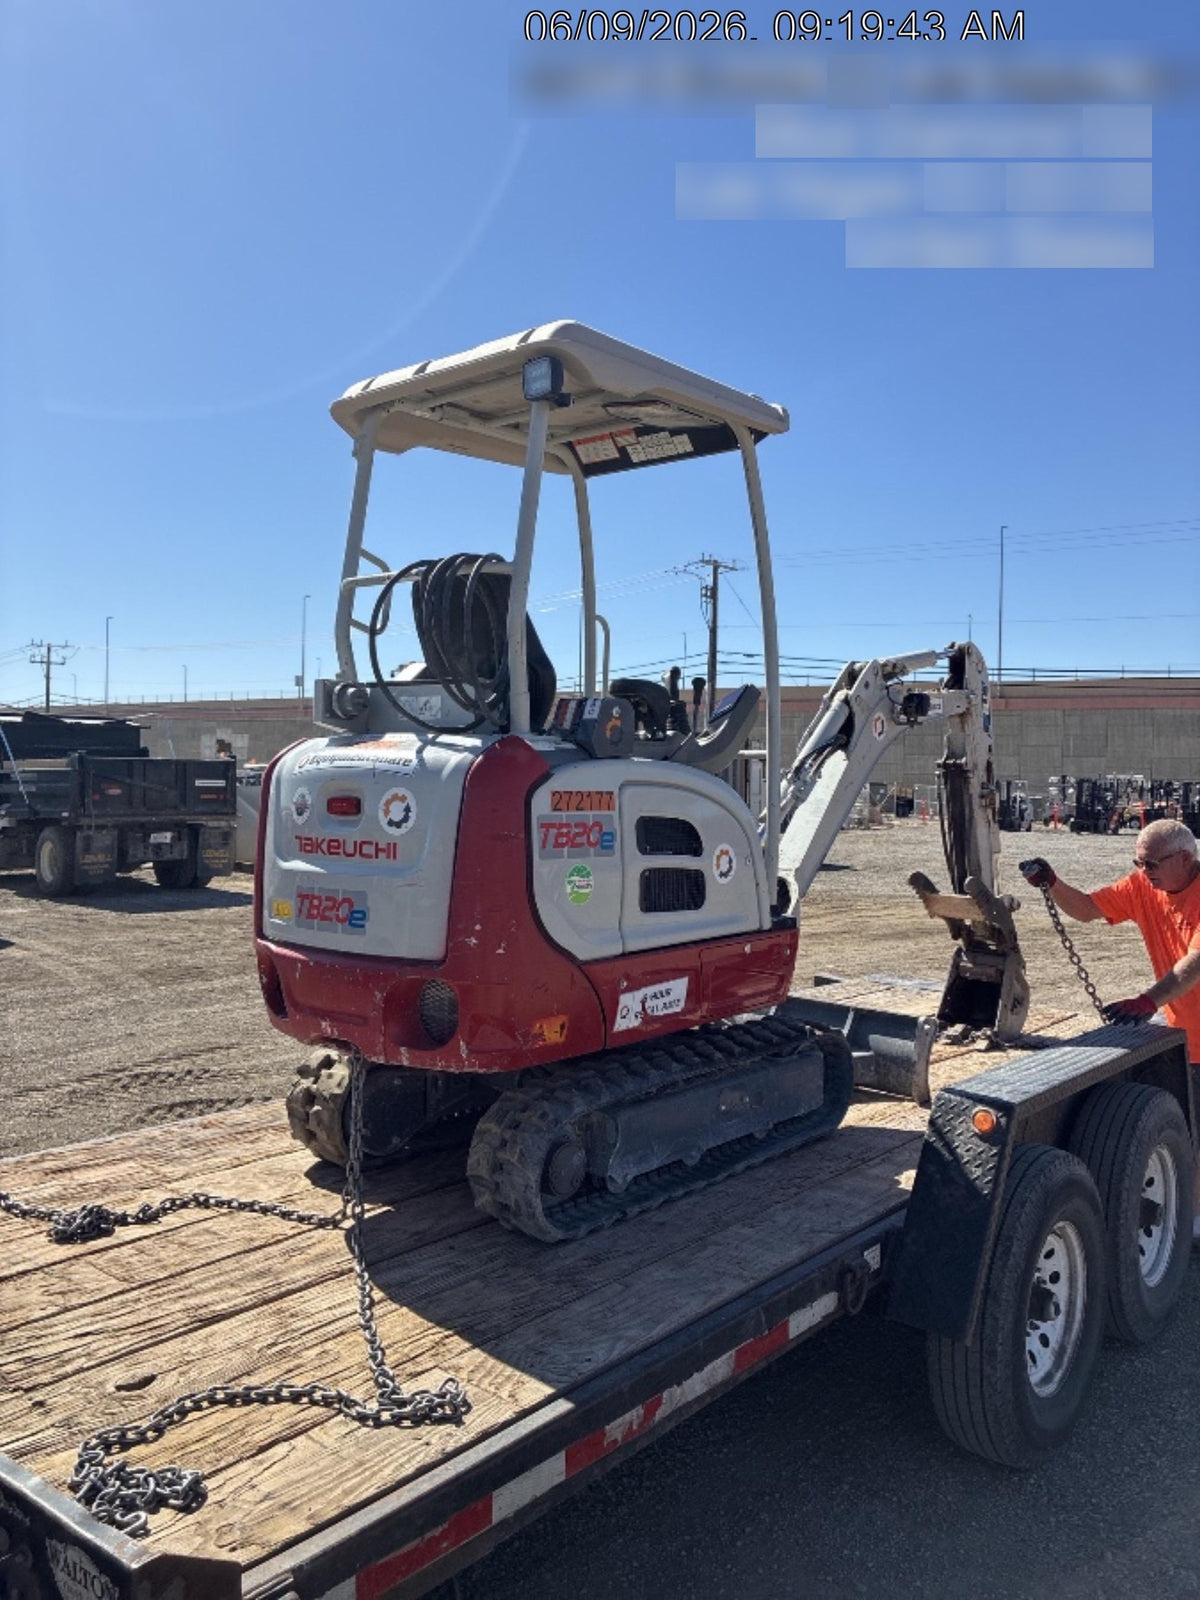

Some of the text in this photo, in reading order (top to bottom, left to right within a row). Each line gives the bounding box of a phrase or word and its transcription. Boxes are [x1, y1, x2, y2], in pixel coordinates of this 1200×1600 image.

[552, 791, 614, 811] 272177
[540, 821, 615, 850] TB20e
[297, 893, 367, 928] TB20e
